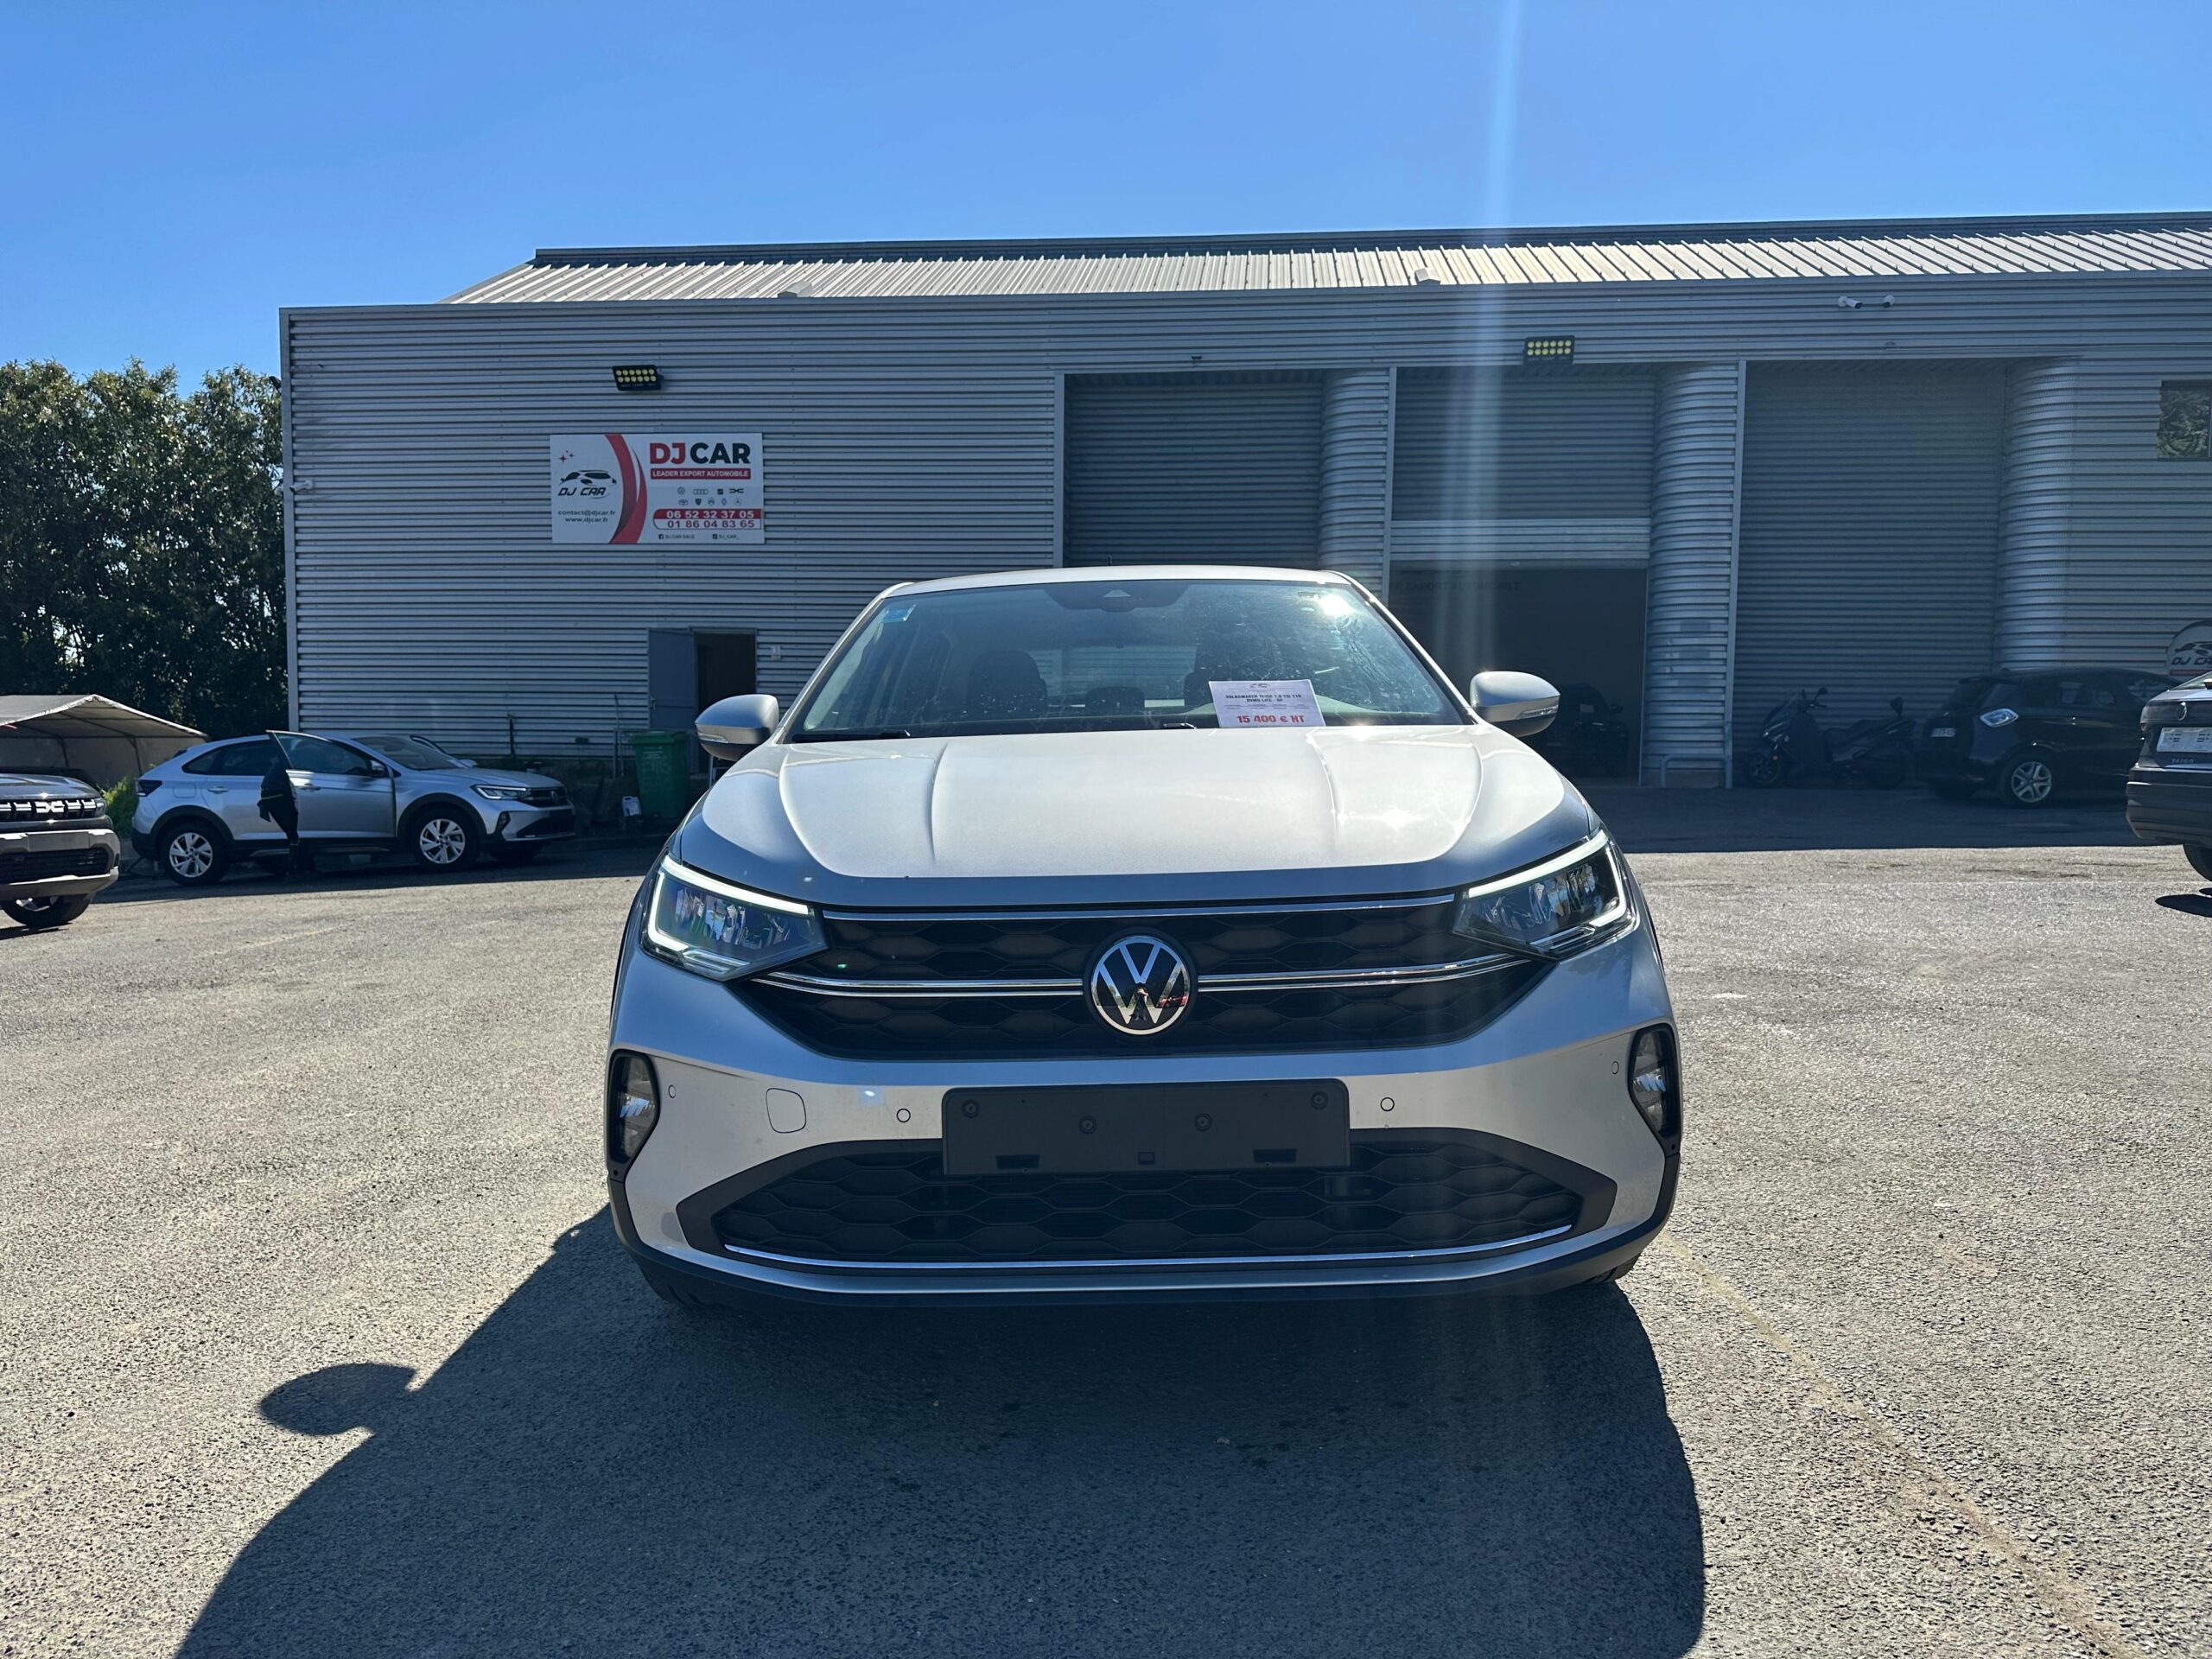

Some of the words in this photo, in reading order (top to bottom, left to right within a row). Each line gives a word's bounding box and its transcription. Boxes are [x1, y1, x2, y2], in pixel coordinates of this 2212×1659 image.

[650, 442, 686, 465] DJ
[690, 442, 751, 465] CAR
[558, 487, 577, 496] DJ
[580, 487, 607, 496] CAR
[2171, 657, 2191, 665] DJ
